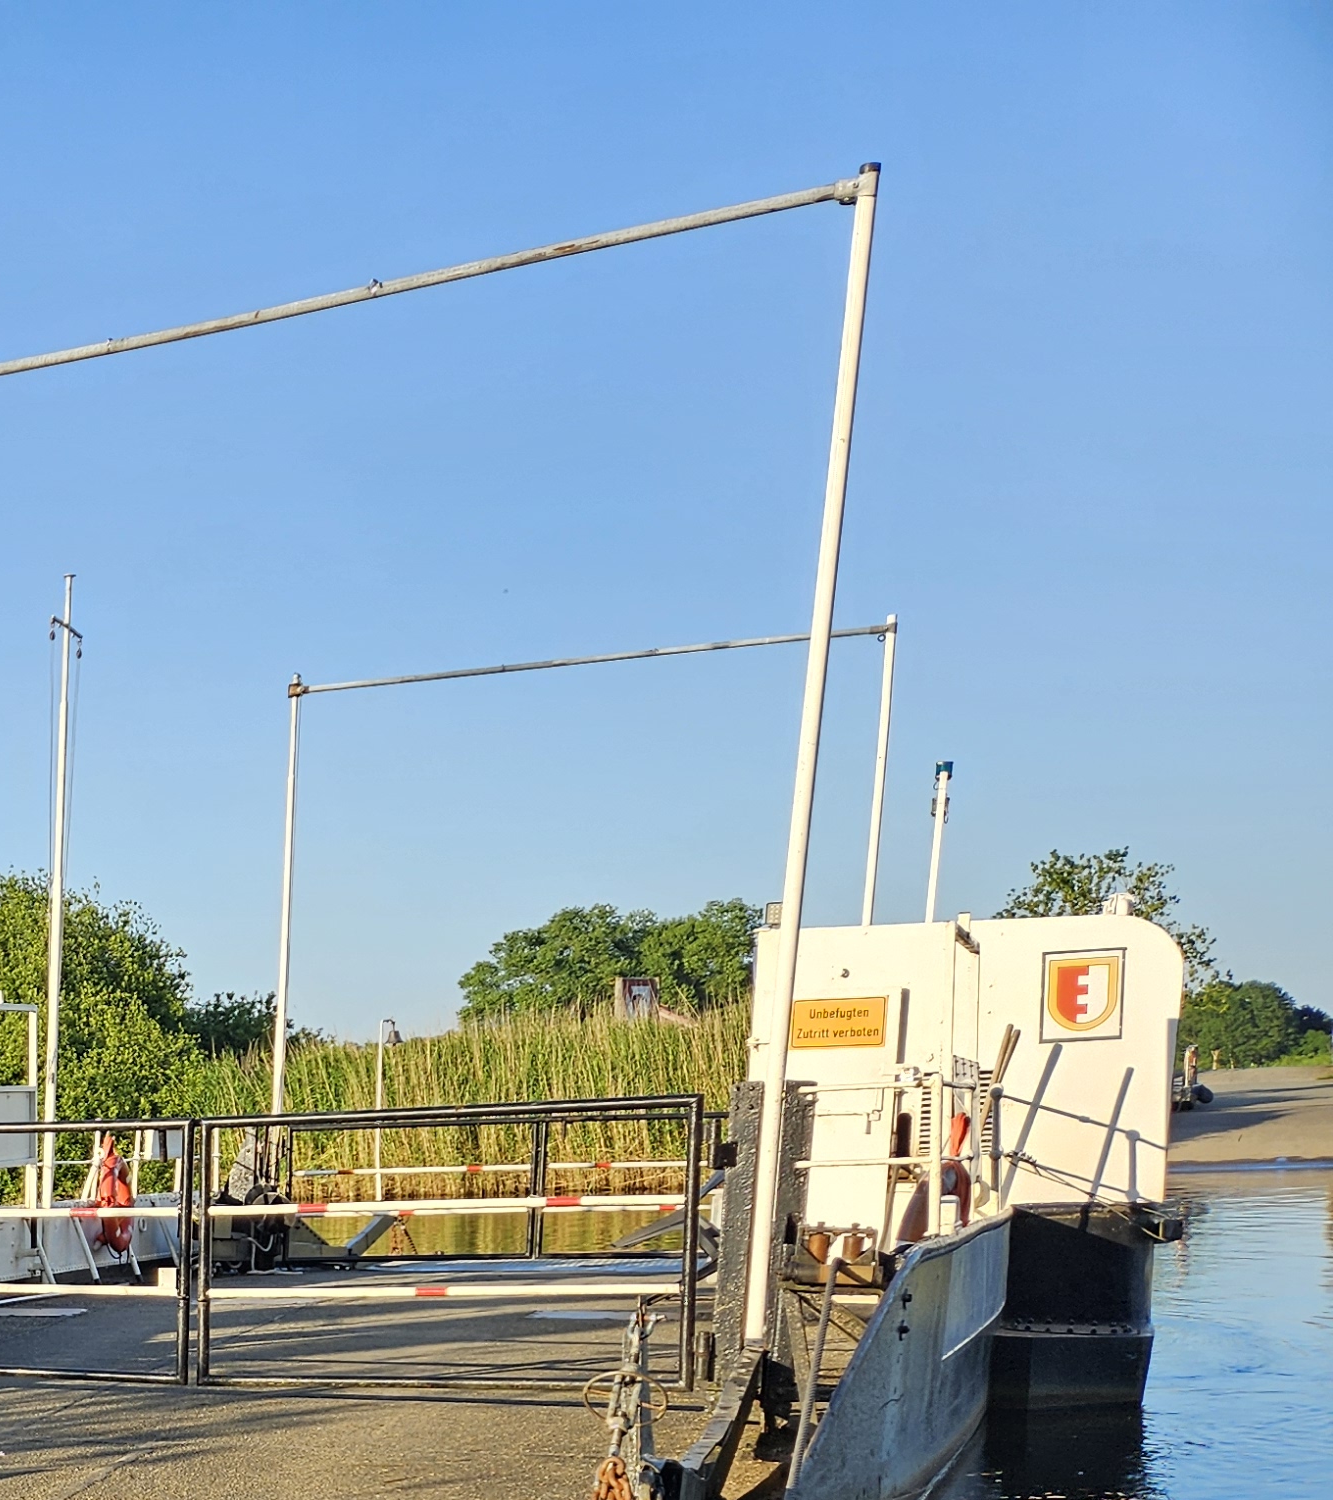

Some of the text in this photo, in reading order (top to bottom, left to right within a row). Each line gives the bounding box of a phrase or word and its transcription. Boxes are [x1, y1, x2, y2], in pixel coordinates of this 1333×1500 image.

[809, 1008, 869, 1020] Unbefugten
[797, 1027, 879, 1039] Zutritt verboten
